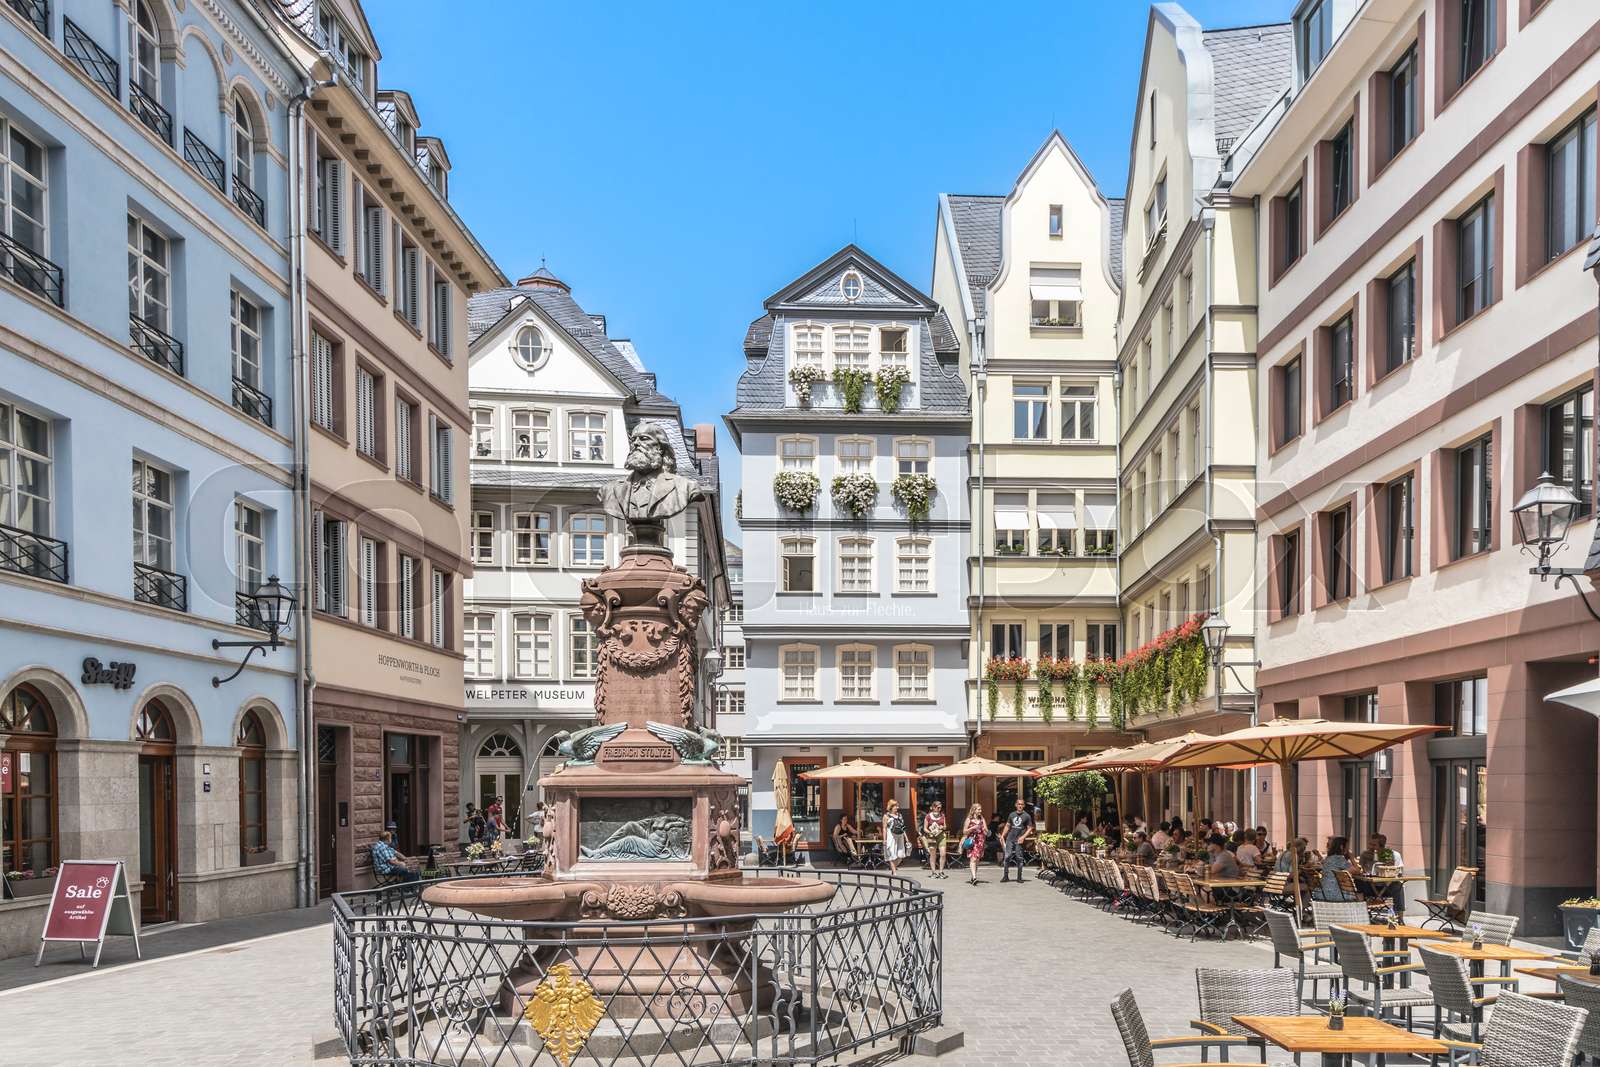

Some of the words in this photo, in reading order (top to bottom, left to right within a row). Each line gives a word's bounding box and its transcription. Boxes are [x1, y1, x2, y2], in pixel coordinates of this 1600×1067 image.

[799, 600, 833, 617] Haus
[81, 657, 136, 689] Steiff
[378, 654, 420, 672] HOPPENWORTH
[424, 665, 441, 677] PLOCH
[533, 690, 585, 700] MUSEUM
[603, 748, 639, 759] FRIEDRICH
[65, 885, 102, 898] Sale
